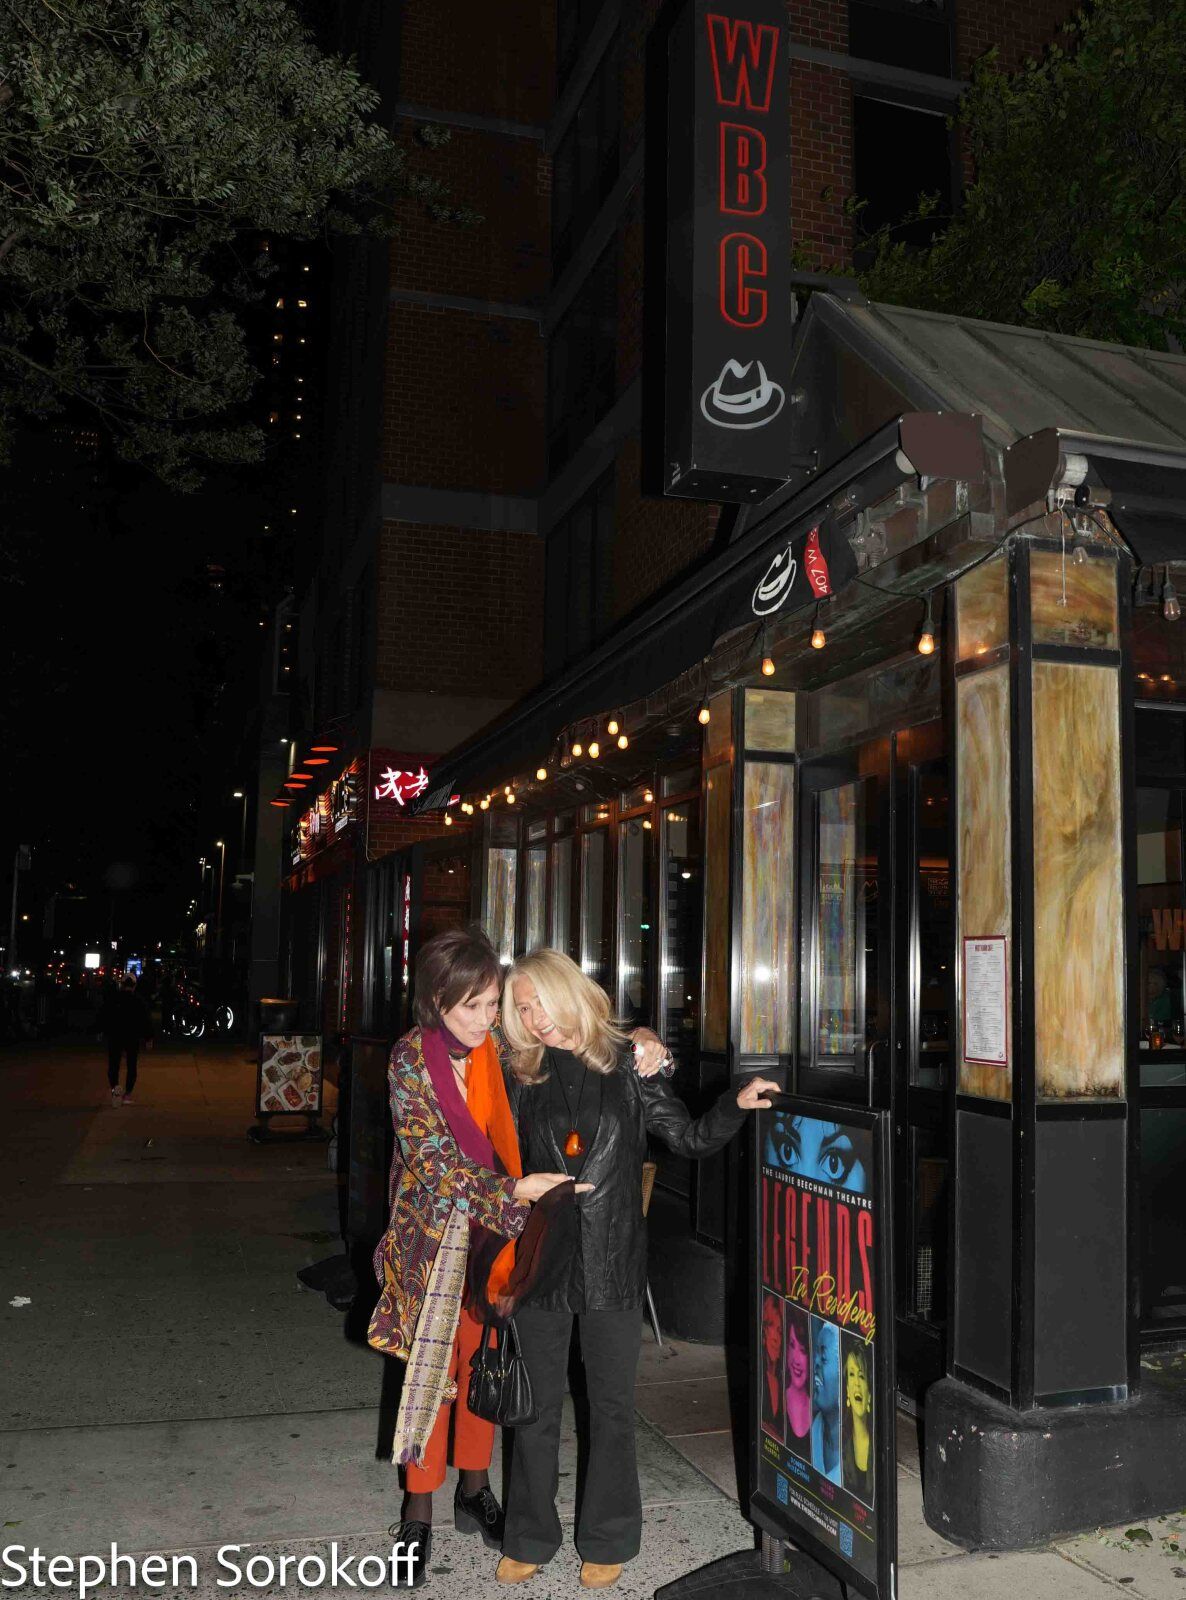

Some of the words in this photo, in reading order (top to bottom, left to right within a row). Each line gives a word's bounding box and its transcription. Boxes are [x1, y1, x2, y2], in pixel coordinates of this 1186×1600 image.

[706, 13, 780, 329] WBC
[807, 549, 817, 564] W
[811, 569, 828, 593] 407
[762, 1166, 773, 1177] THE
[775, 1170, 795, 1185] LAURIE
[796, 1178, 833, 1198] BEECHMAN
[836, 1191, 872, 1209] THEATRE
[761, 1176, 874, 1334] LEGENDS
[785, 1265, 809, 1300] In
[809, 1271, 876, 1345] Residency
